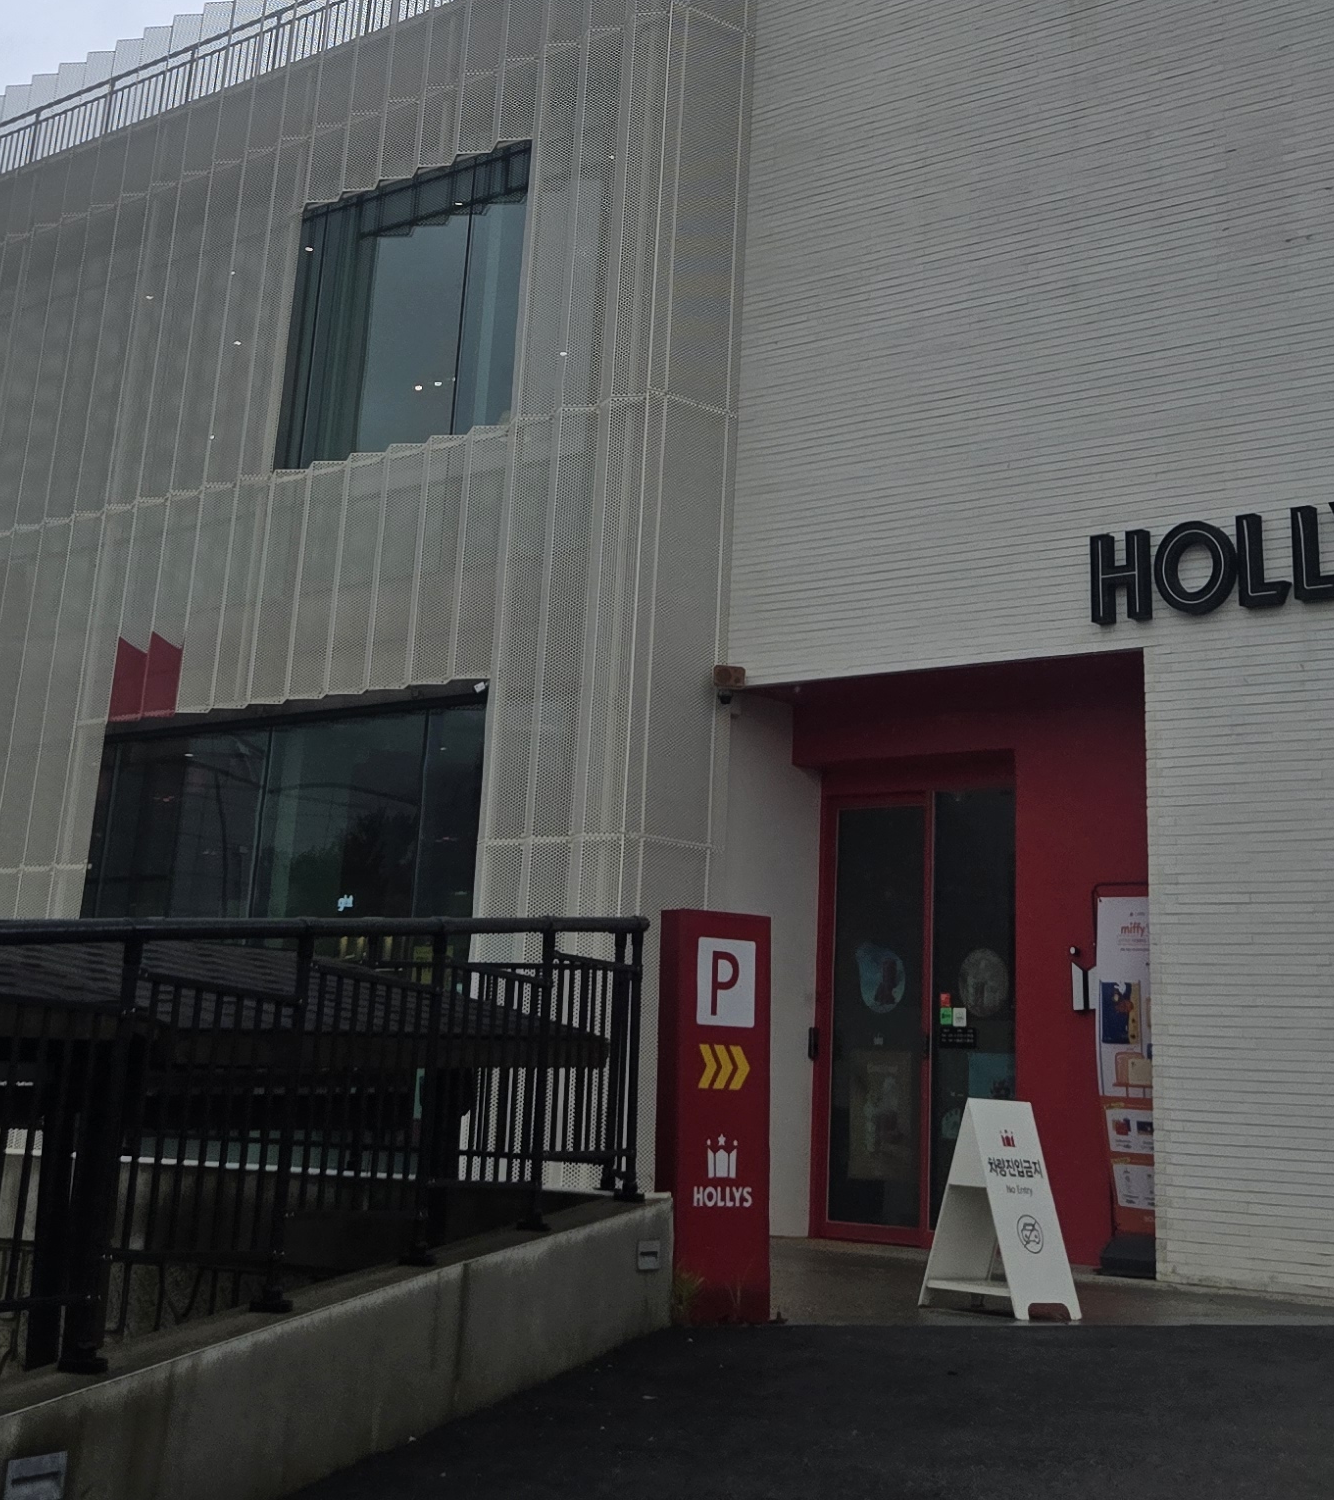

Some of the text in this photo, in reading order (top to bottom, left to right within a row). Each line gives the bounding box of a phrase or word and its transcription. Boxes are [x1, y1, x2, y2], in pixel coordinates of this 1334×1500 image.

[1120, 922, 1145, 937] miffy
[710, 950, 740, 1016] P
[988, 1157, 1044, 1179] 차량진입금지
[693, 1185, 753, 1208] HOLLYS
